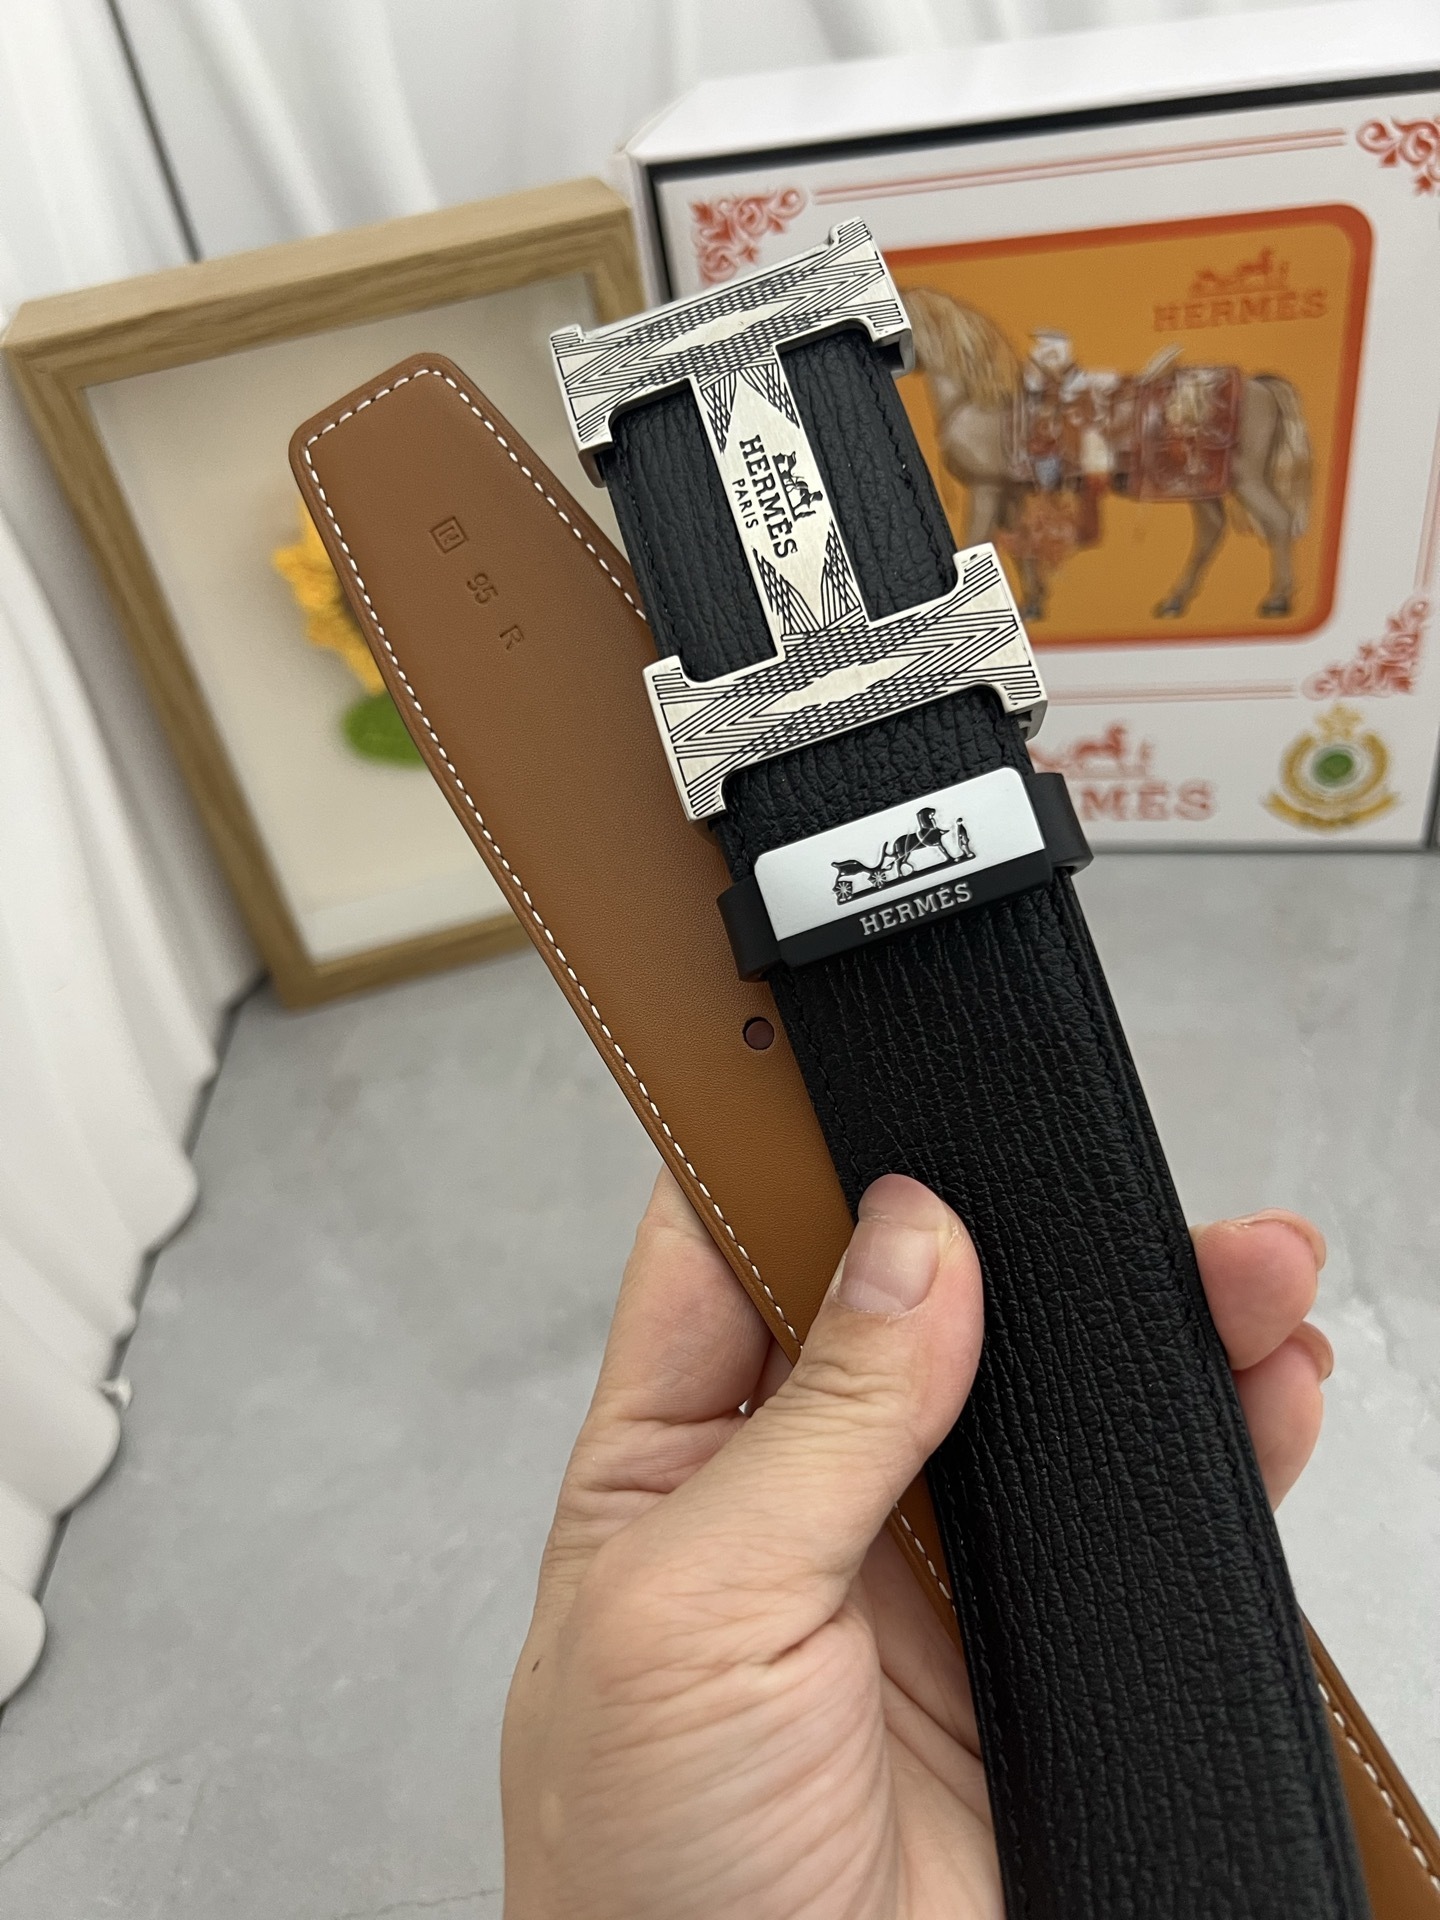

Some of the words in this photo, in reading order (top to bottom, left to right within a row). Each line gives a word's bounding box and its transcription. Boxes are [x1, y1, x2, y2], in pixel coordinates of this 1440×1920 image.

[731, 478, 759, 530] PARIS
[466, 572, 499, 604] 95
[499, 624, 525, 651] R
